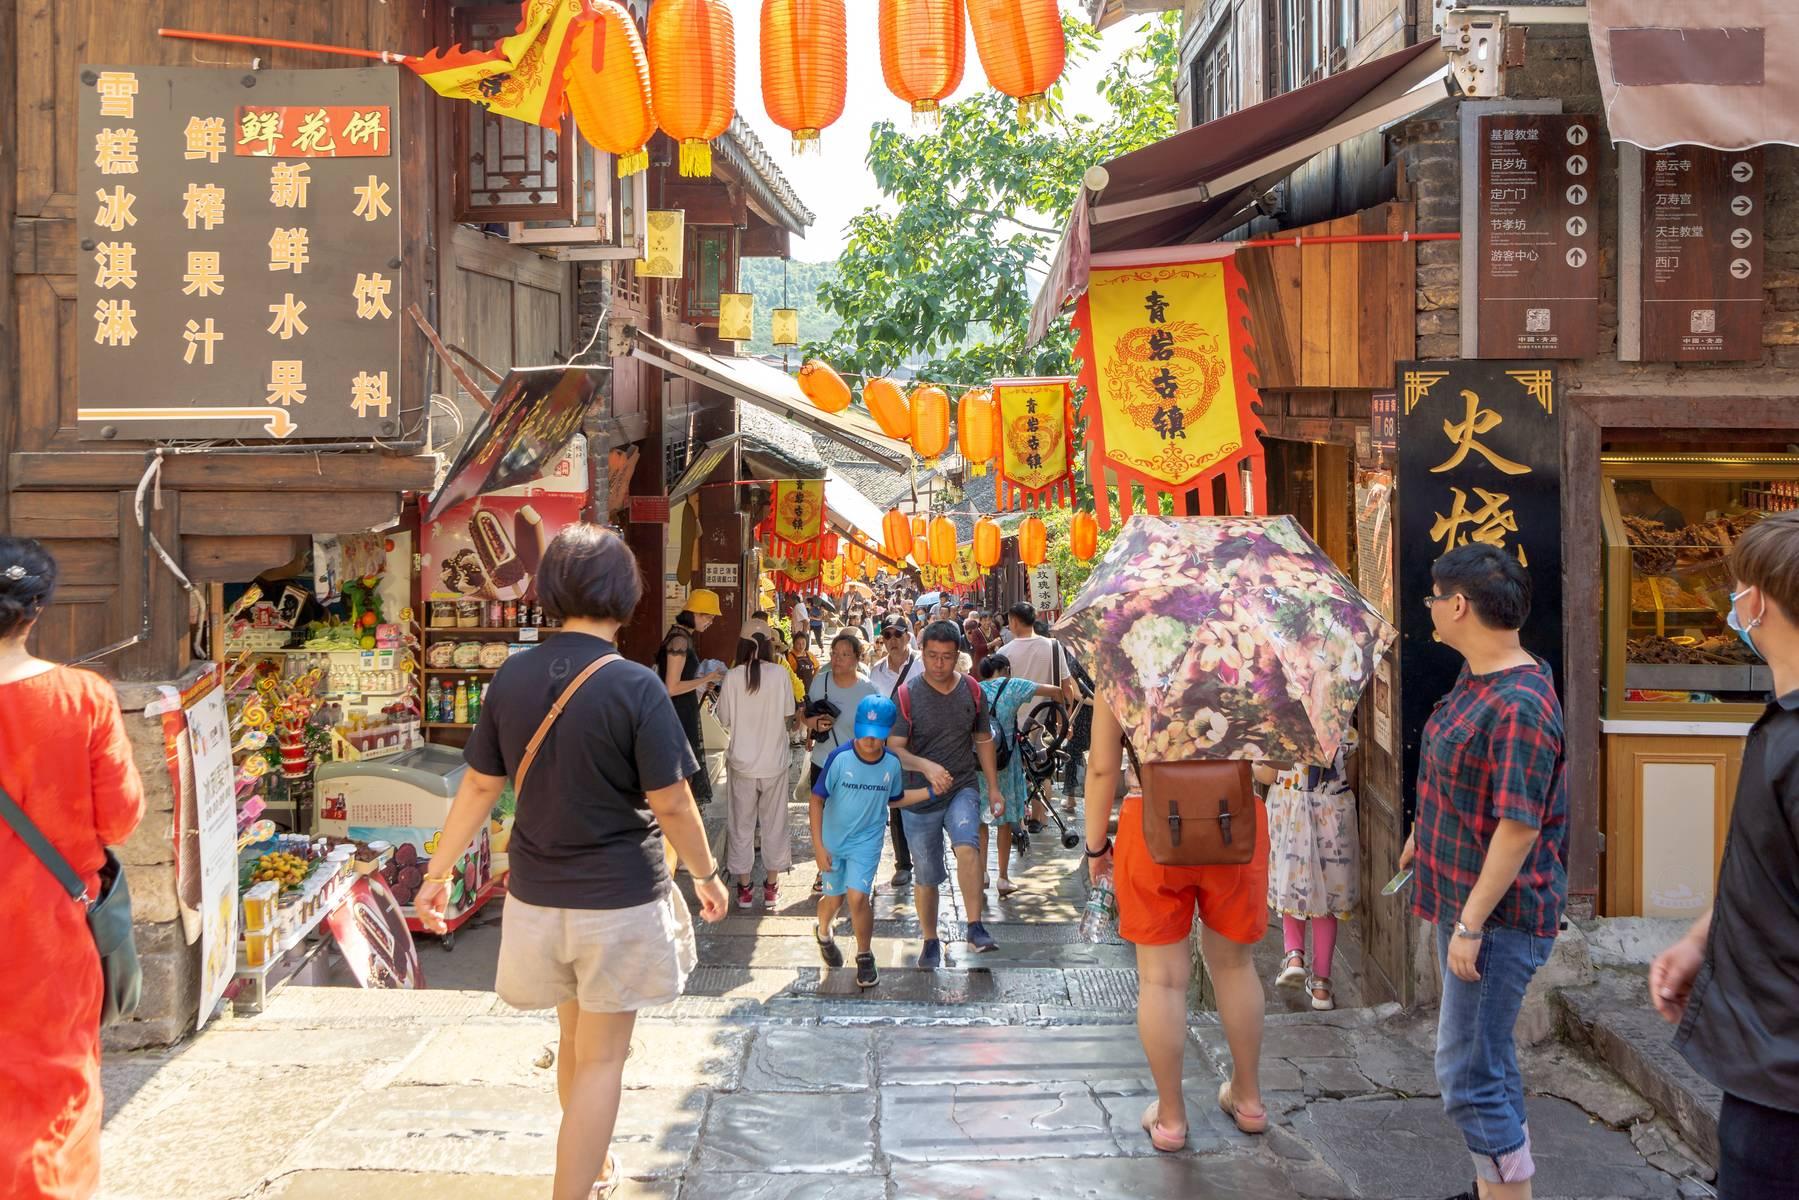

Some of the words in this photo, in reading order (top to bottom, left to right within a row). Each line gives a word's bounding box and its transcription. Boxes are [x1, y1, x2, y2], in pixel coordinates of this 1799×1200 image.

[238, 111, 387, 155] 鲜花饼
[1490, 129, 1540, 141] 基督教堂
[1490, 158, 1528, 170] 百岁坊
[1655, 159, 1692, 172] 慈云寺
[1490, 188, 1527, 200] 定广门
[1655, 192, 1692, 206] 万寿宫
[95, 71, 140, 346] 雪糕冰淇淋
[1490, 219, 1527, 231] 节孝坊
[1655, 225, 1704, 238] 天主教堂
[182, 117, 227, 365] 鲜榨果汁
[1490, 250, 1540, 262] 游客中心
[1655, 256, 1679, 269] 西门
[267, 162, 311, 406] 新鲜水果
[351, 174, 393, 418] 水饮料
[1144, 290, 1187, 440] 青岩古镇
[1026, 397, 1042, 469] 青岩古镇
[1384, 416, 1394, 437] 68
[1037, 570, 1051, 610] 玫瑰冰粉
[841, 781, 859, 789] ANTA
[858, 783, 889, 792] FOOTBALL
